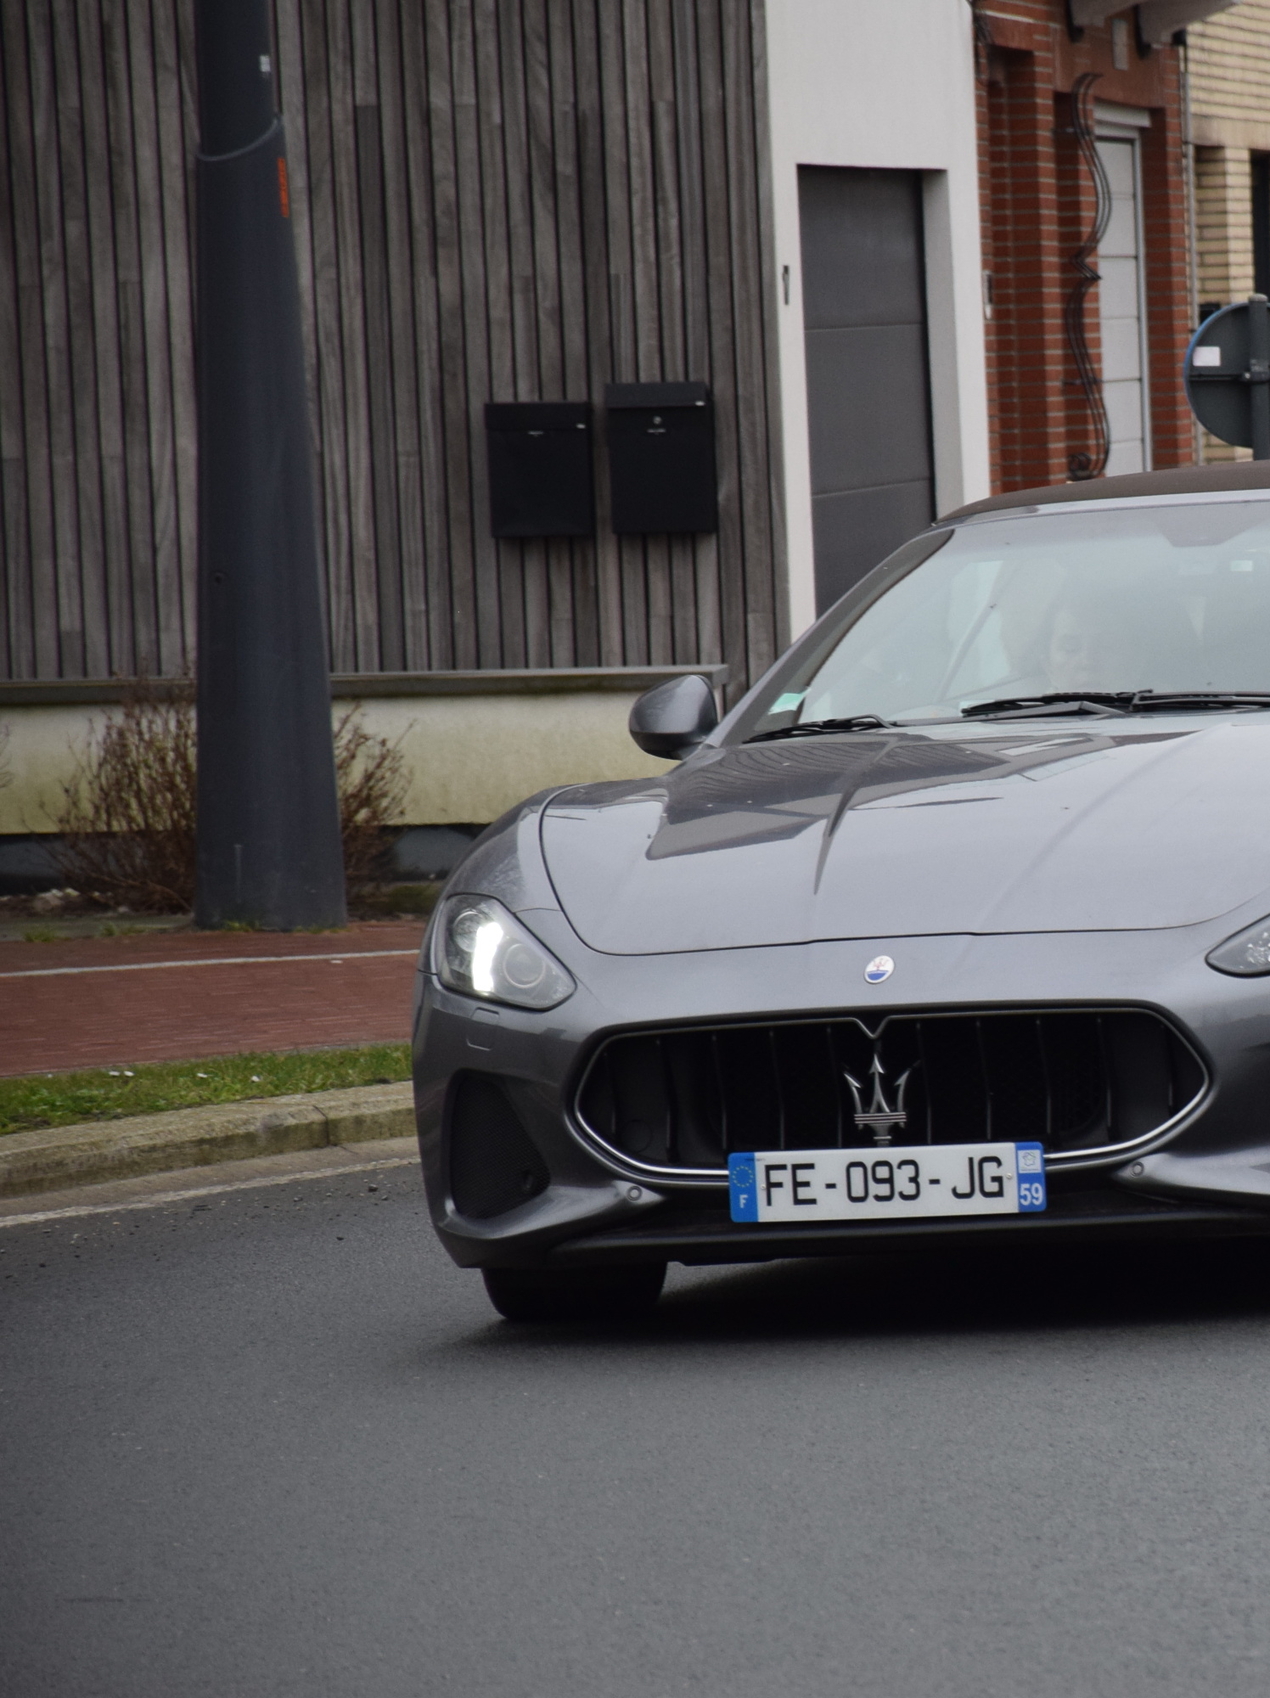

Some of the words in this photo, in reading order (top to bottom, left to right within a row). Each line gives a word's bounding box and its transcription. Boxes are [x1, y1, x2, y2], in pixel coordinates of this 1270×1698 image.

[764, 1156, 1005, 1206] FE-093-JG
[739, 1194, 748, 1208] F
[1020, 1183, 1043, 1205] 59
